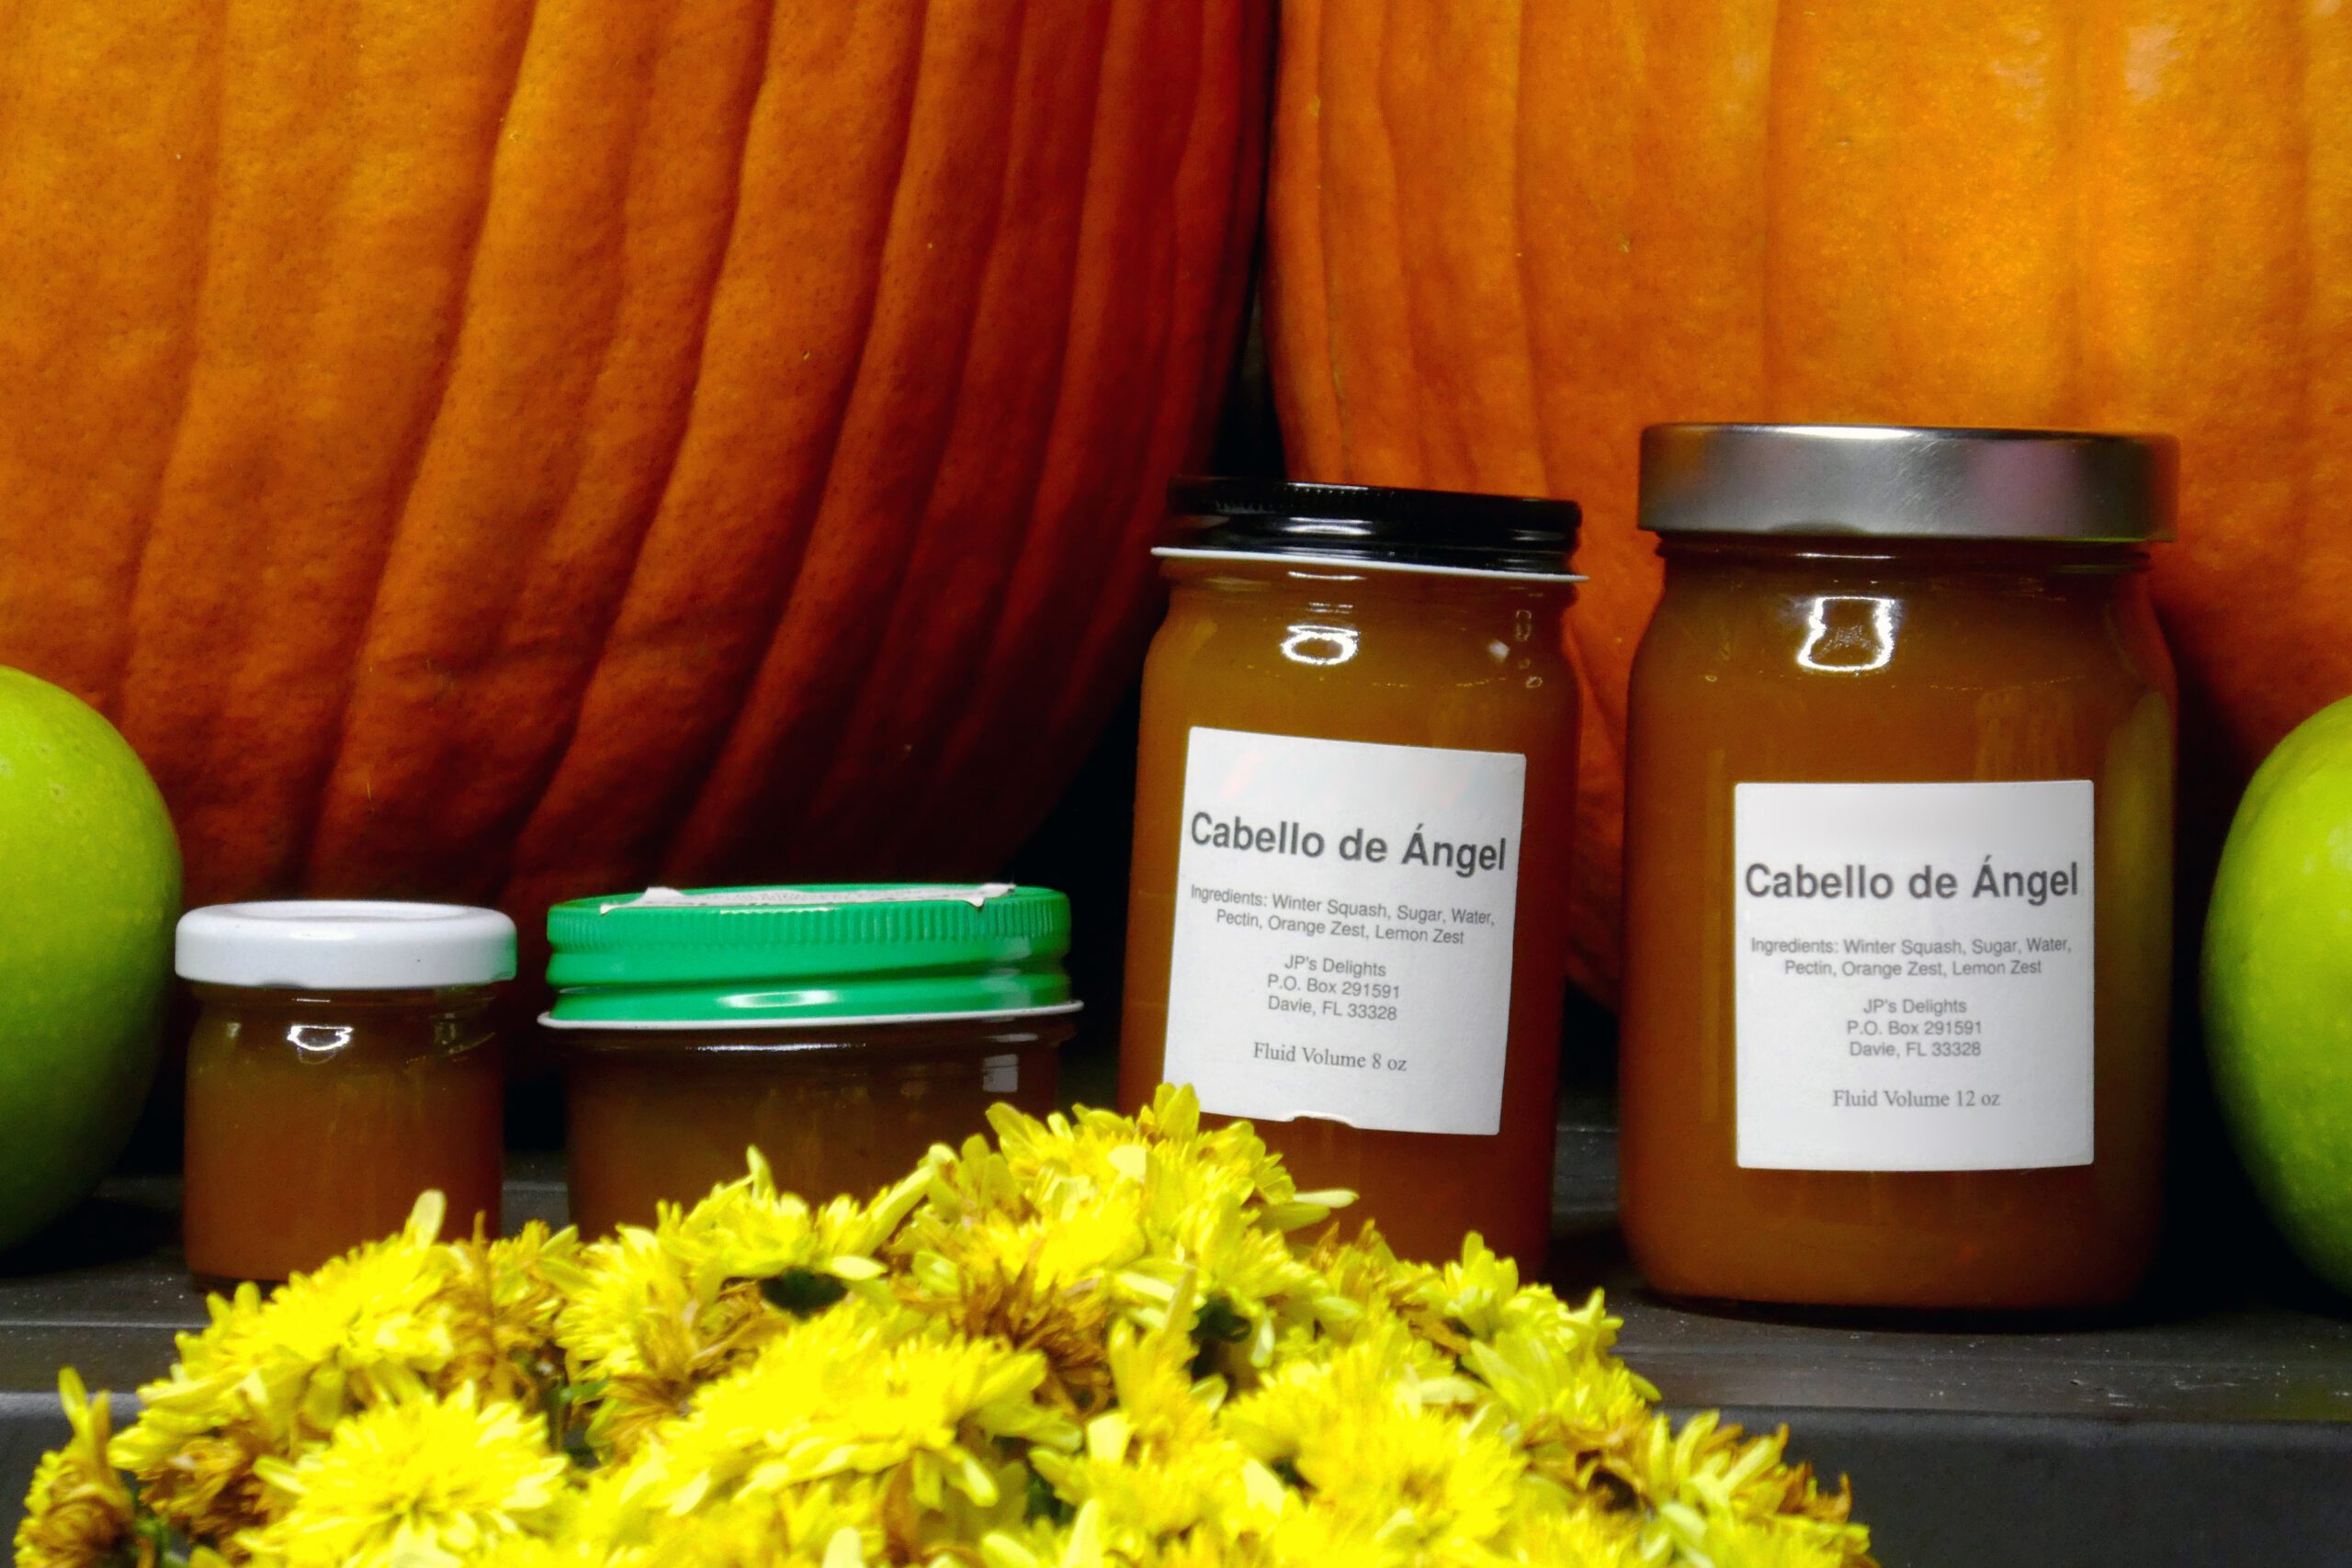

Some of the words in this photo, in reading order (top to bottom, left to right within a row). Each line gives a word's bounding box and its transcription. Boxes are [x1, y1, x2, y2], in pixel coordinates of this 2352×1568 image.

[1191, 811, 1325, 858] Cabello
[1340, 829, 1387, 863] de
[1402, 824, 1507, 877] Ángel
[1746, 863, 1894, 899] Cabello
[1909, 864, 1957, 898] de
[1972, 855, 2077, 906] Ángel
[1191, 884, 1268, 908] Ingredients:
[1272, 894, 1321, 913] Winter
[1328, 900, 1391, 919] Squash,
[1396, 906, 1446, 926] Sugar,
[1452, 909, 1495, 926] Water,
[1216, 909, 1263, 930] Pectin,
[1269, 916, 1326, 936] Orange
[1330, 921, 1369, 941] Zest,
[1375, 926, 1429, 942] Lemon
[1432, 929, 1464, 944] Zest
[1751, 938, 1838, 956] Ingredients:
[1843, 939, 1895, 954] Winter
[1902, 939, 1966, 956] Squash,
[1972, 938, 2021, 956] Sugar,
[2026, 937, 2072, 954] Water,
[1284, 955, 1317, 972] JP's
[1323, 959, 1386, 978] Delights
[1785, 961, 1837, 977] Pectin,
[1842, 962, 1902, 979] Orange
[1907, 961, 1947, 977] Zest,
[1952, 961, 2006, 976] Lemon
[2010, 960, 2041, 975] Zest
[1268, 975, 1301, 992] P.O.
[1306, 978, 1337, 994] Box
[1341, 982, 1400, 998] 291591
[1269, 996, 1316, 1016] Davie,
[1322, 1001, 1342, 1017] FL
[1347, 1003, 1396, 1021] 33328
[1863, 998, 1897, 1014] JP's
[1903, 998, 1966, 1017] Delights
[1847, 1021, 1882, 1035] P.O.
[1889, 1021, 1919, 1035] Box
[1924, 1021, 1982, 1035] 291591
[1254, 1043, 1295, 1063] Fluid
[1301, 1047, 1366, 1068] Volume
[1372, 1054, 1382, 1069] 8
[1387, 1057, 1407, 1072] oz
[1849, 1042, 1900, 1058] Davie,
[1906, 1042, 1927, 1056] FL
[1932, 1042, 1981, 1056] 33328
[1832, 1090, 1878, 1107] Fluid
[1883, 1090, 1950, 1107] Volume
[1956, 1090, 1974, 1107] 12
[1981, 1093, 2000, 1107] oz
